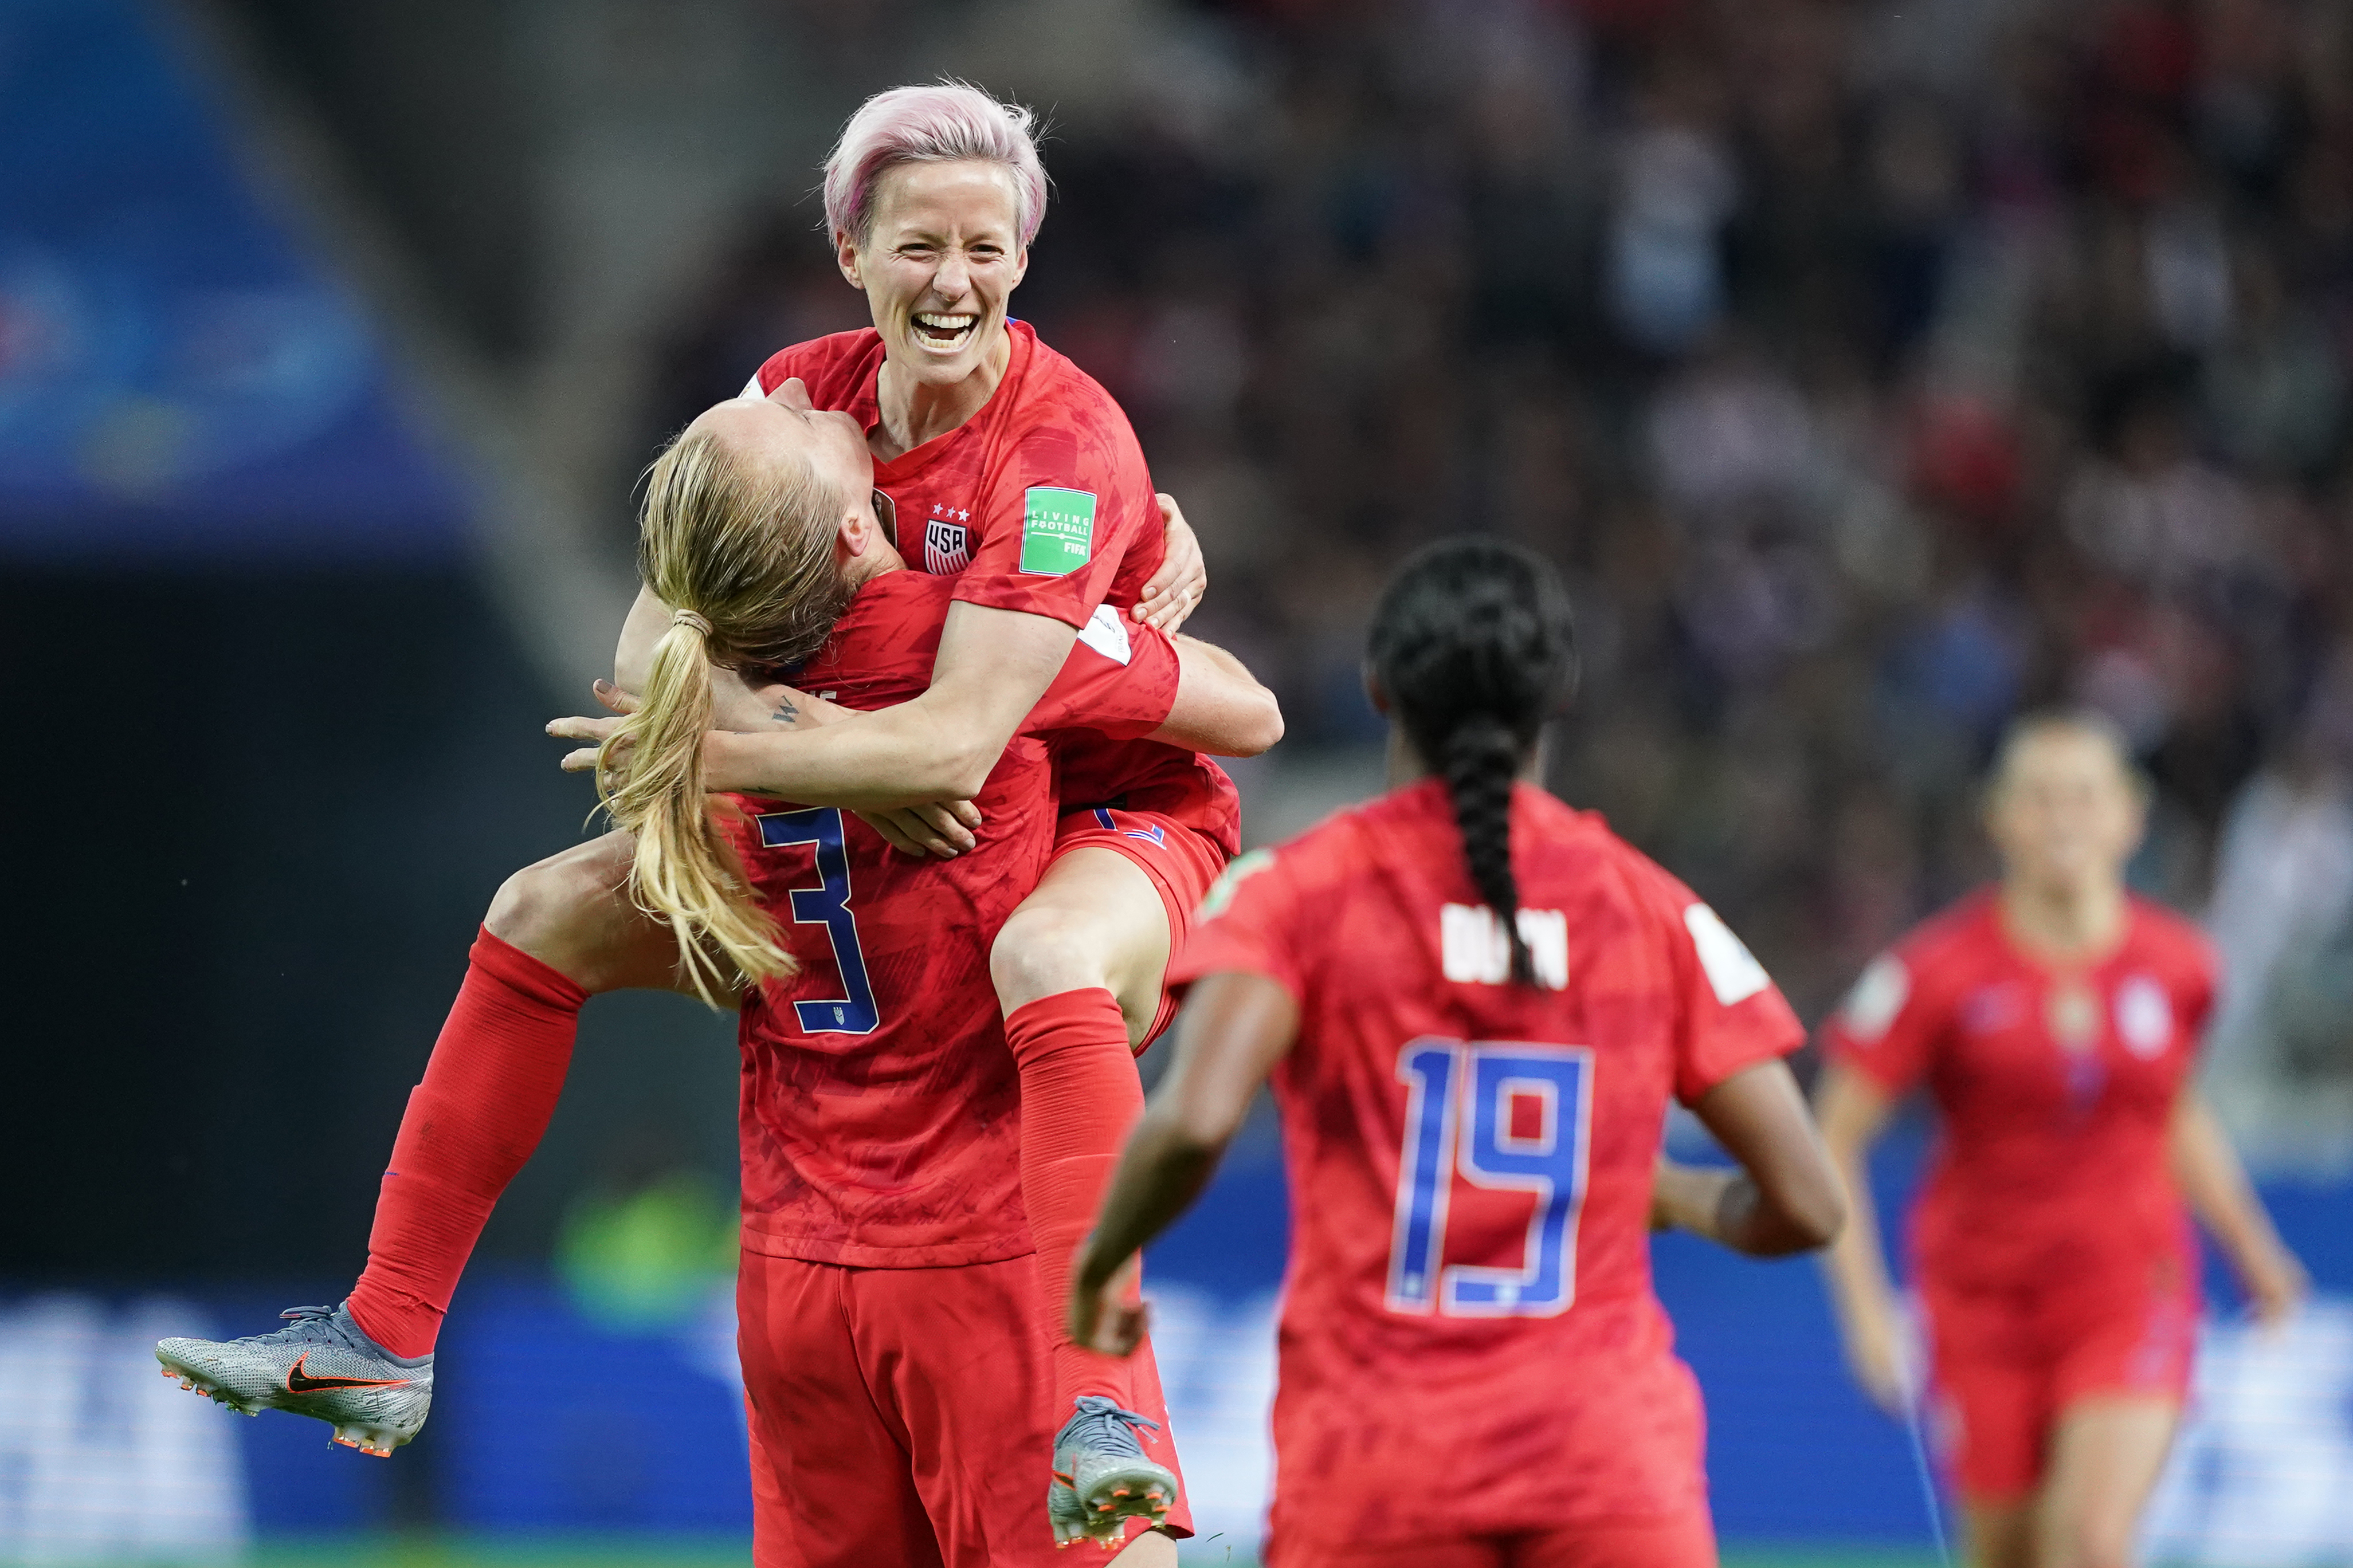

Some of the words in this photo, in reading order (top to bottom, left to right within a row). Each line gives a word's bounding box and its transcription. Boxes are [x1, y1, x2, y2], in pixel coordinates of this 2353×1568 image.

[1031, 519, 1088, 536] FOOTBALL
[1032, 510, 1089, 526] LIVING
[928, 524, 963, 554] USA
[1064, 541, 1087, 556] FIFA
[755, 806, 880, 1035] 3
[1383, 1033, 1597, 1319] 19
